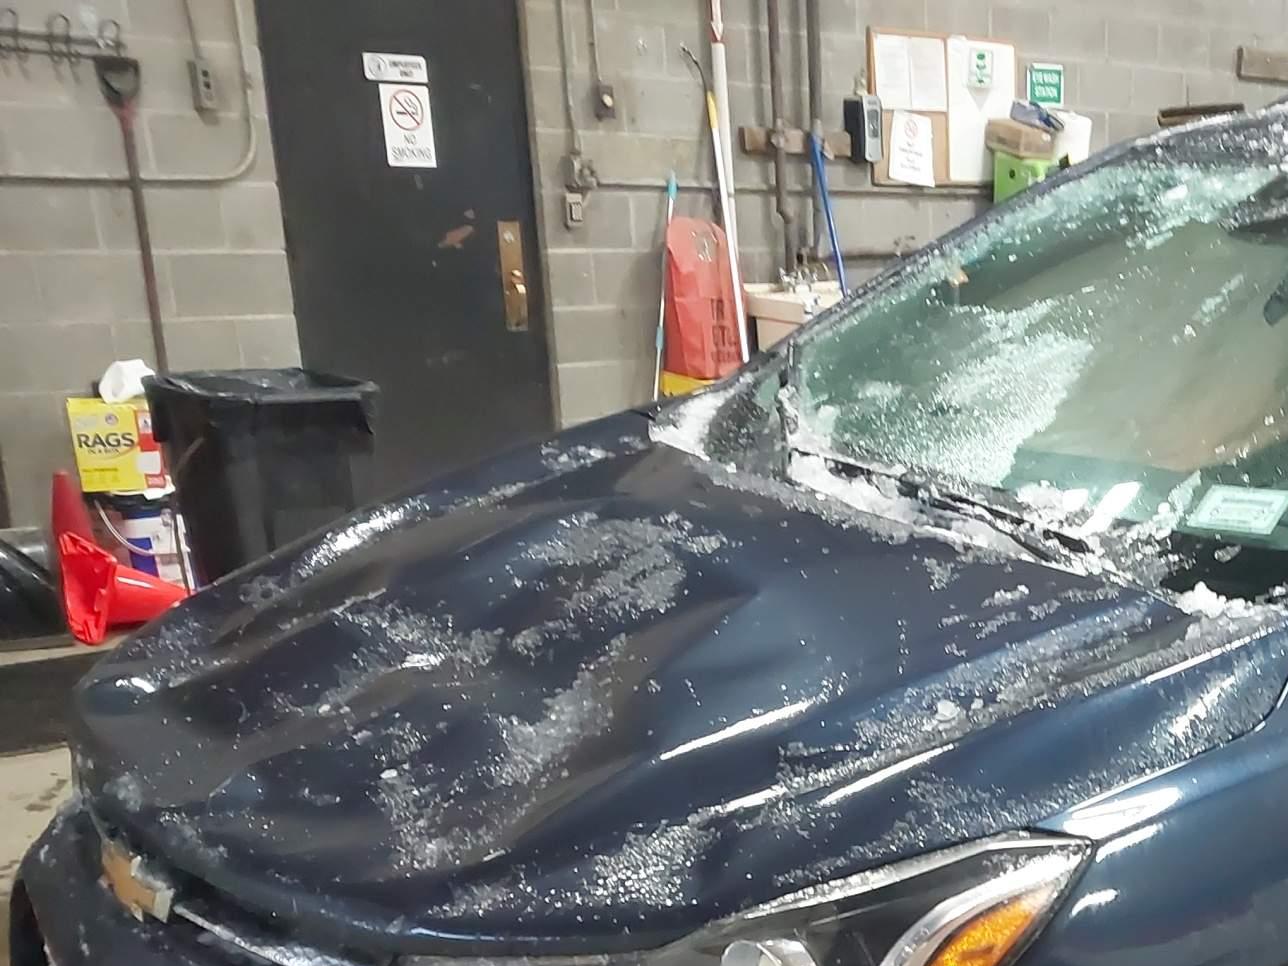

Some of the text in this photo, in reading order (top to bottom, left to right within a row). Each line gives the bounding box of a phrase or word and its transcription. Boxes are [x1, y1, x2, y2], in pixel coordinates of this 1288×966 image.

[403, 134, 417, 145] NO
[391, 146, 432, 160] SMOKING
[76, 432, 135, 449] RAGS
